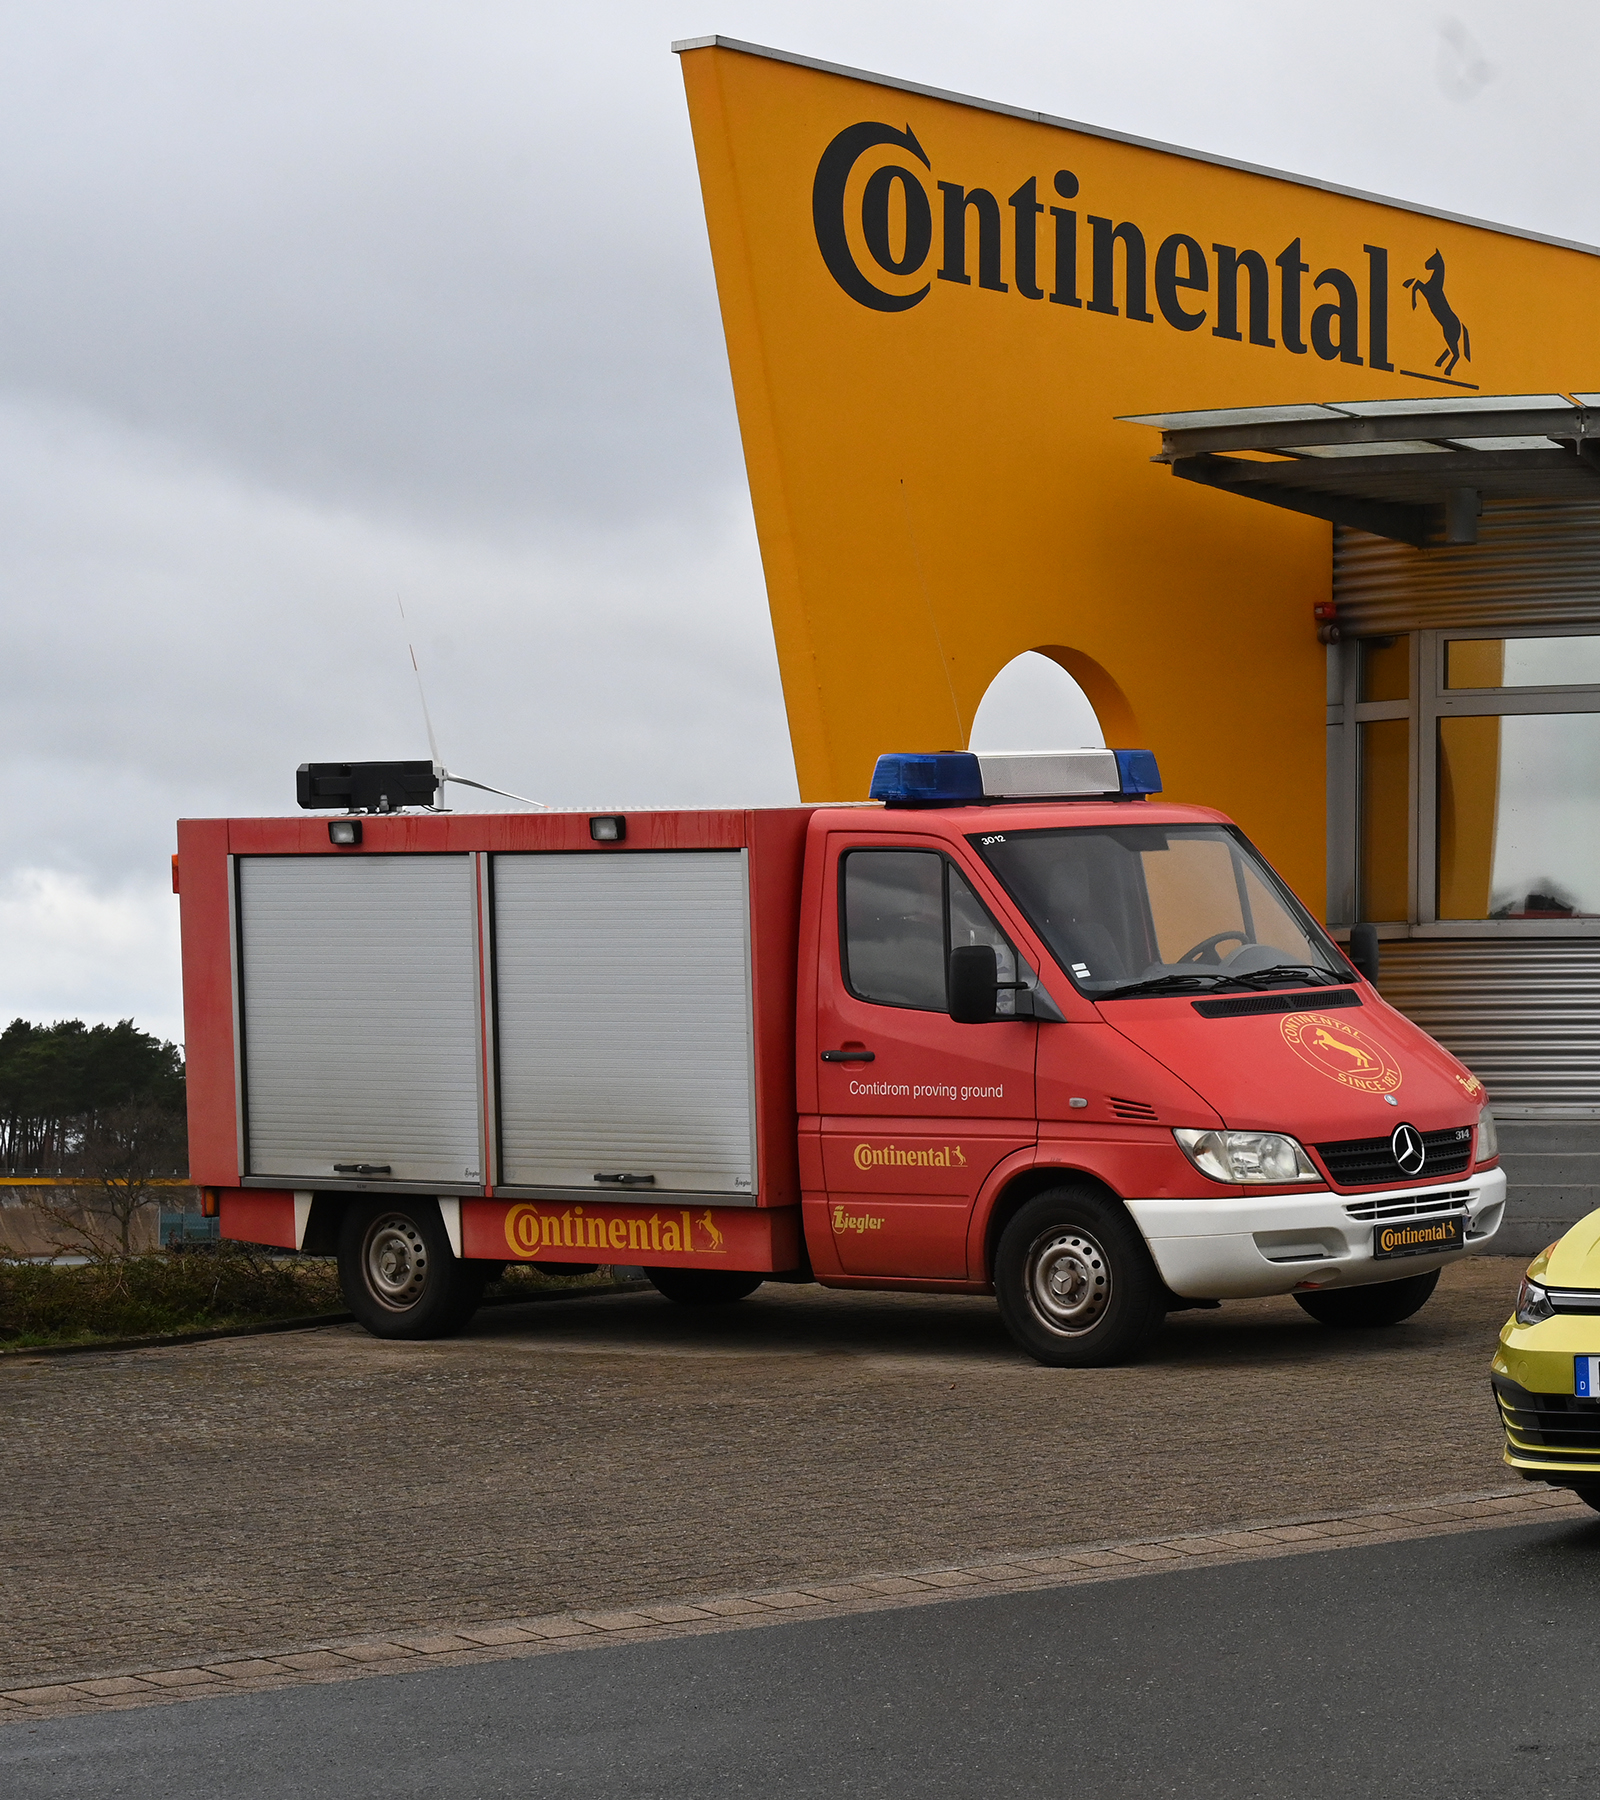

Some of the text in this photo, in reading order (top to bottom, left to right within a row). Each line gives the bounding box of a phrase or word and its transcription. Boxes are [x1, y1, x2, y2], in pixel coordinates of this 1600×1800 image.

[812, 121, 1394, 373] Continental
[981, 834, 1007, 846] 3012
[1284, 1014, 1361, 1044] CONTINENTAL
[849, 1080, 1003, 1101] Contidrom proving ground
[1337, 1068, 1399, 1091] SINCE 1871
[1455, 1129, 1470, 1140] 314
[853, 1143, 952, 1171] Continental
[504, 1202, 695, 1257] Continental
[833, 1205, 885, 1235] Ziegler
[1381, 1222, 1447, 1252] Continental
[1580, 1381, 1586, 1390] D
